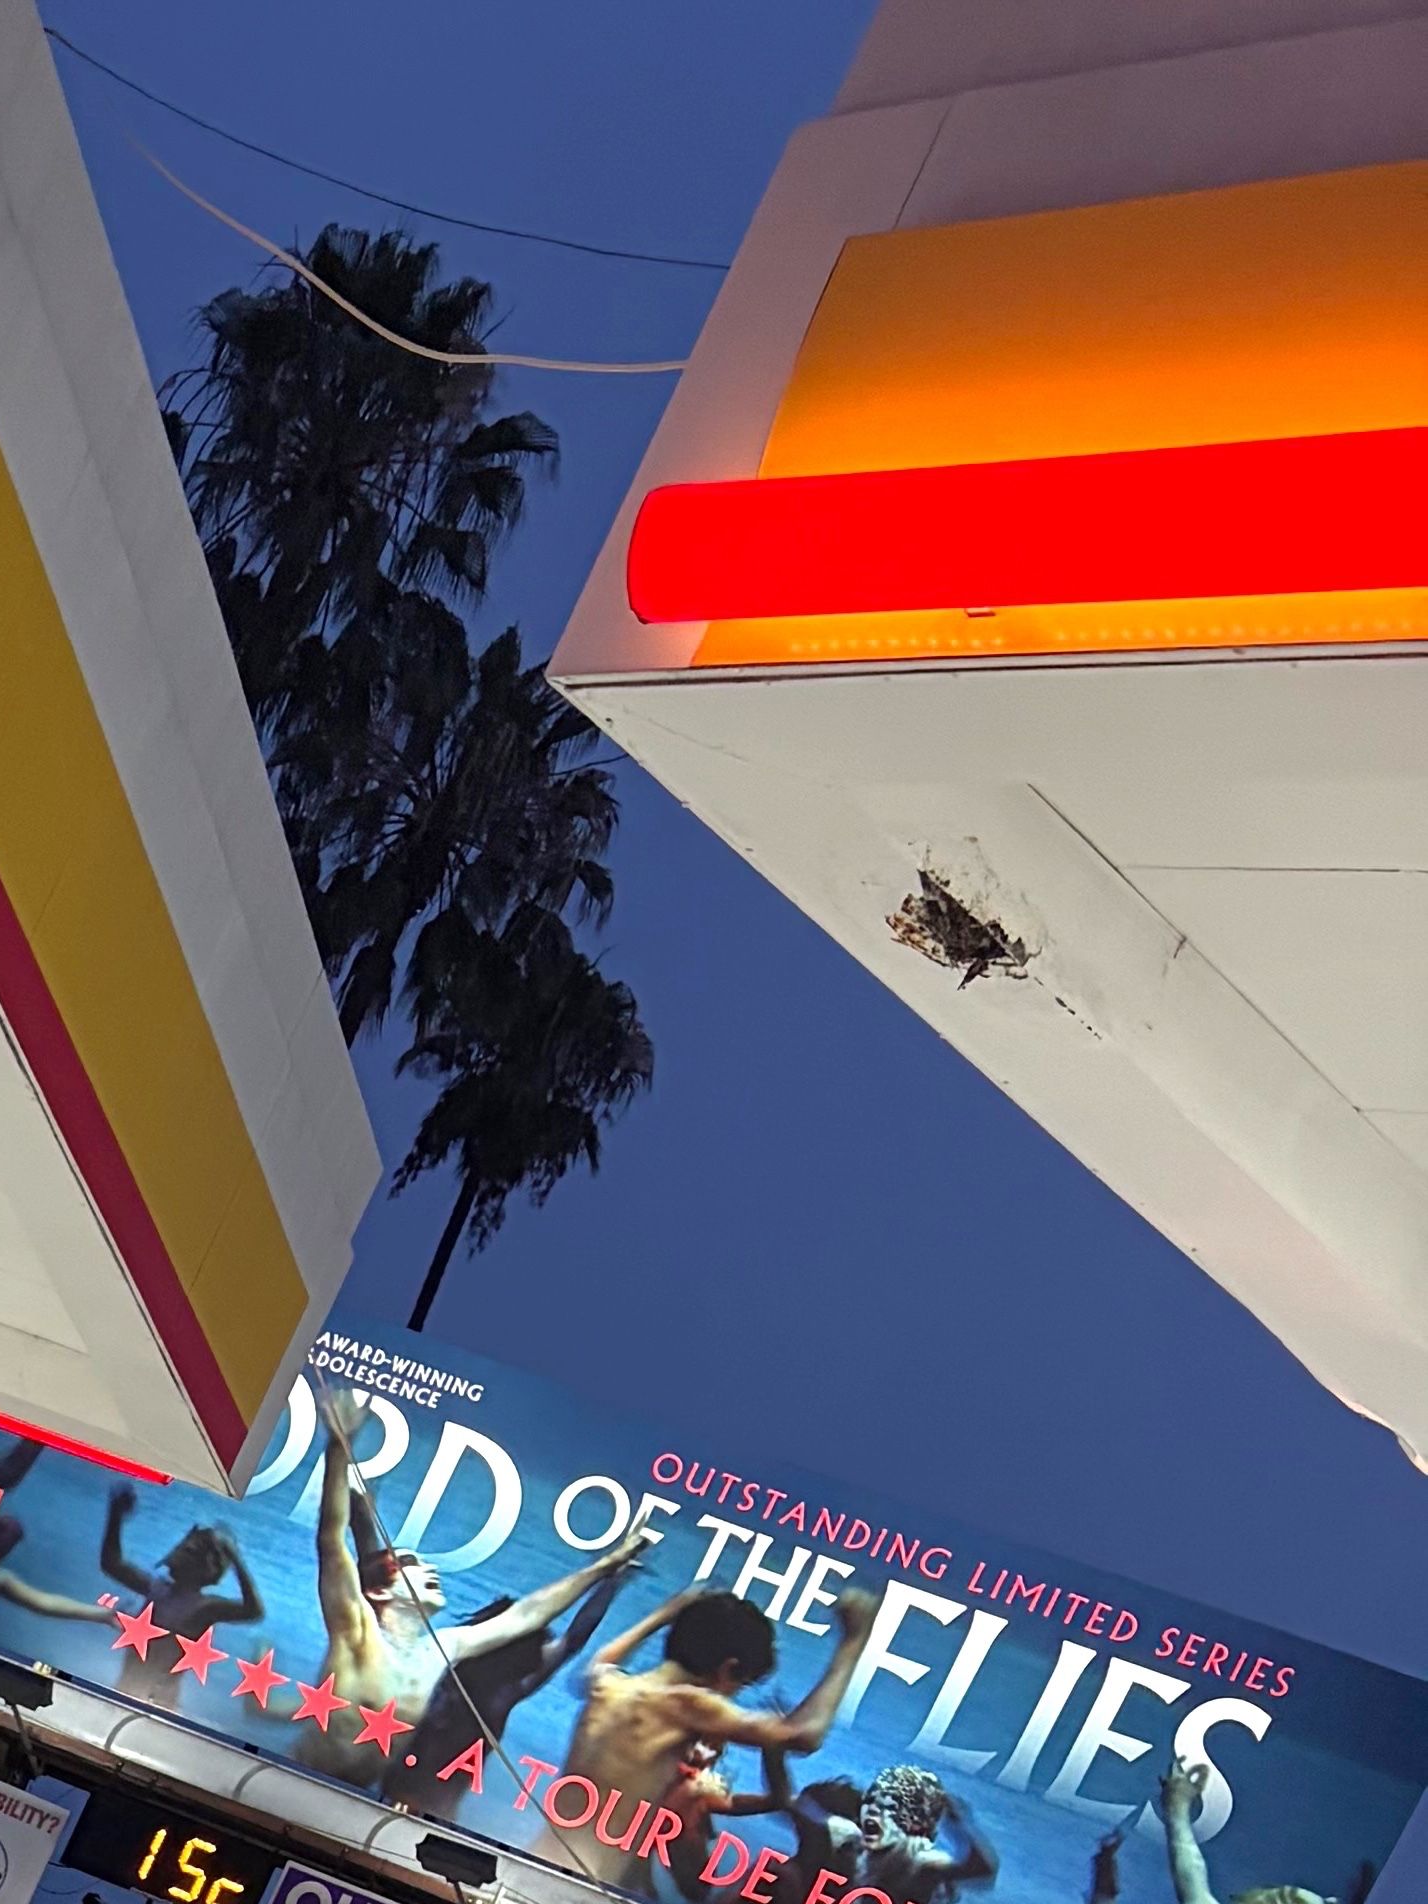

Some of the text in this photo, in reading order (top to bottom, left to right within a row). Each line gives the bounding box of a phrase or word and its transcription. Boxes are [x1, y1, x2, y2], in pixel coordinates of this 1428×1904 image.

[316, 1331, 485, 1402] AWARD-WINNING
[652, 1451, 1297, 1698] OUTSTANDING LIMITED SERIES
[692, 1513, 856, 1636] THE
[835, 1578, 1272, 1844] FLIES
[436, 1739, 487, 1796] A
[508, 1755, 683, 1868] TOUR
